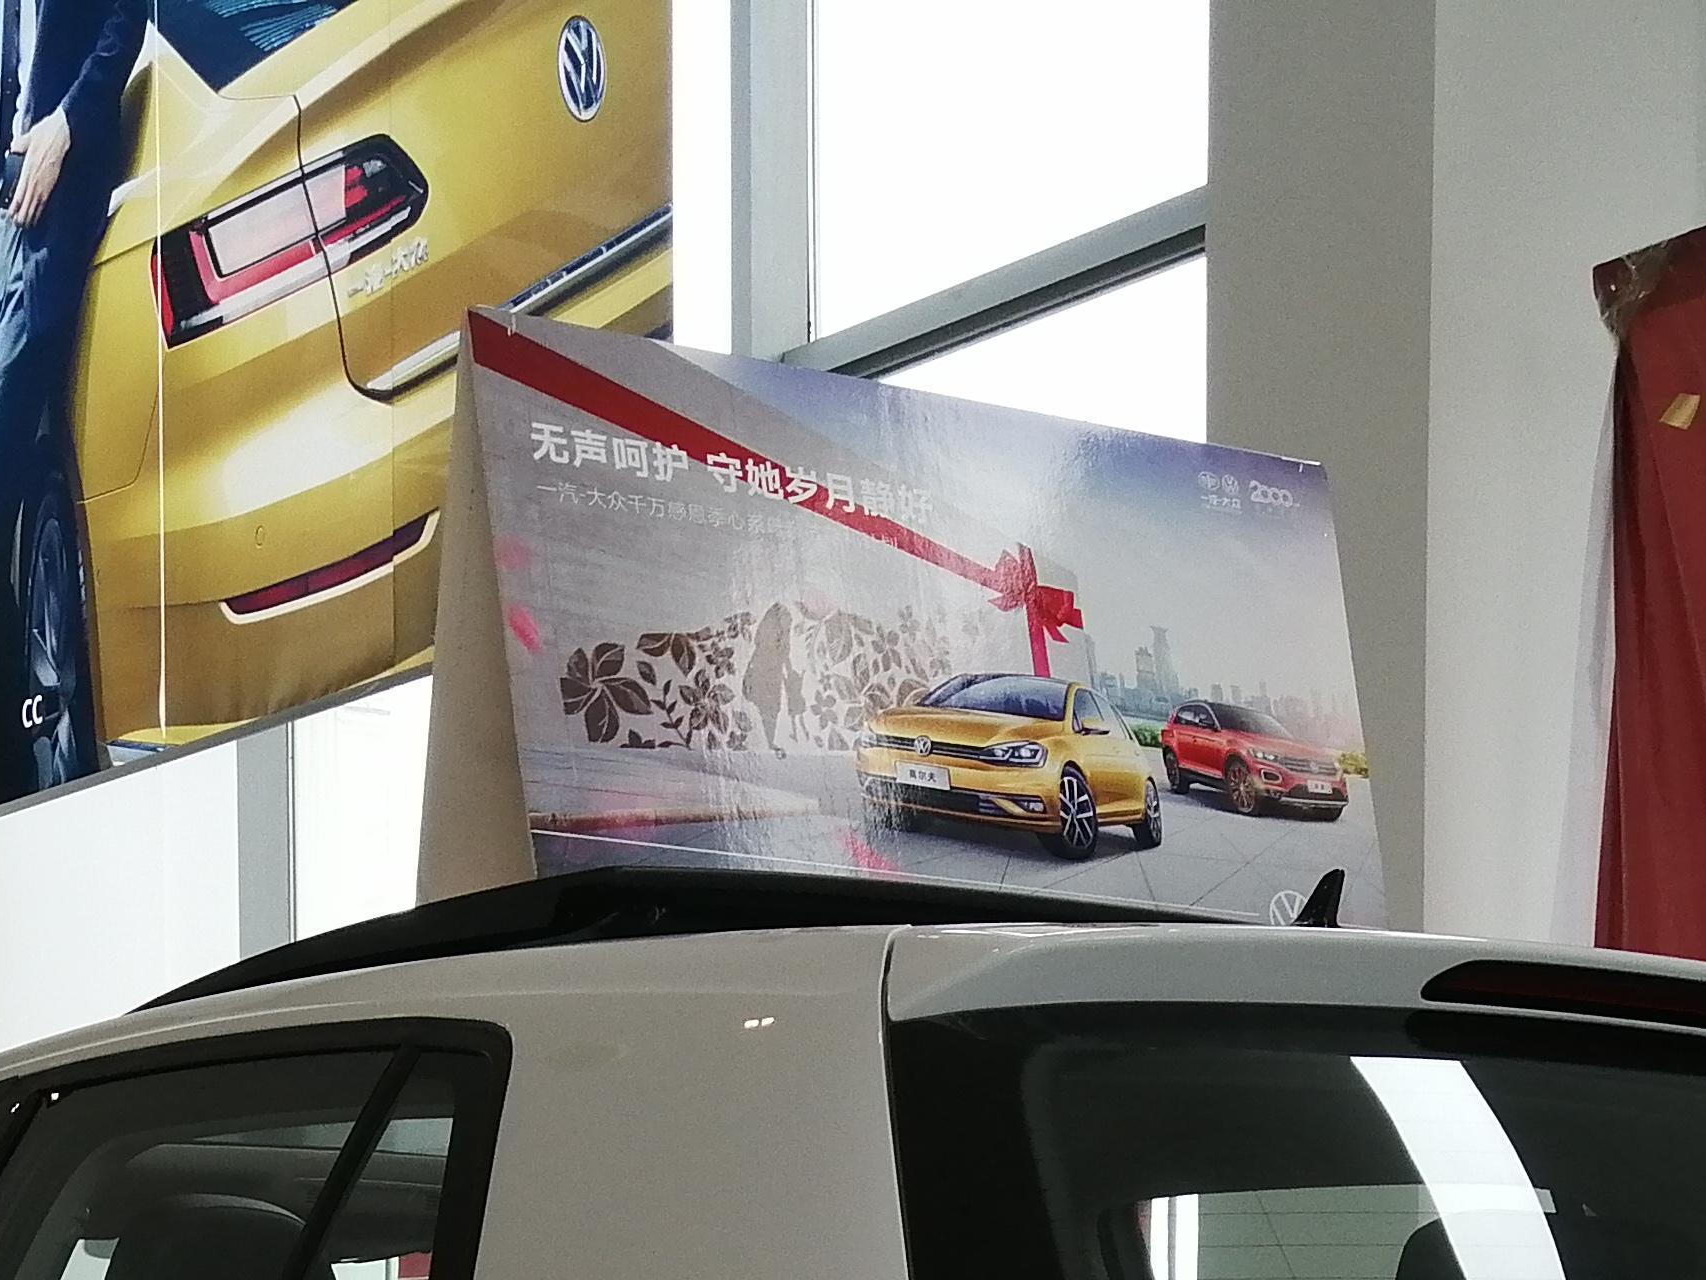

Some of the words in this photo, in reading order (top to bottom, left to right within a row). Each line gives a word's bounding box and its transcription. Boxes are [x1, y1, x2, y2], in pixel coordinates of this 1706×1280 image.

[530, 421, 689, 482] 无声呵护
[707, 452, 934, 524] 守她岁月静好
[22, 694, 43, 728] CC
